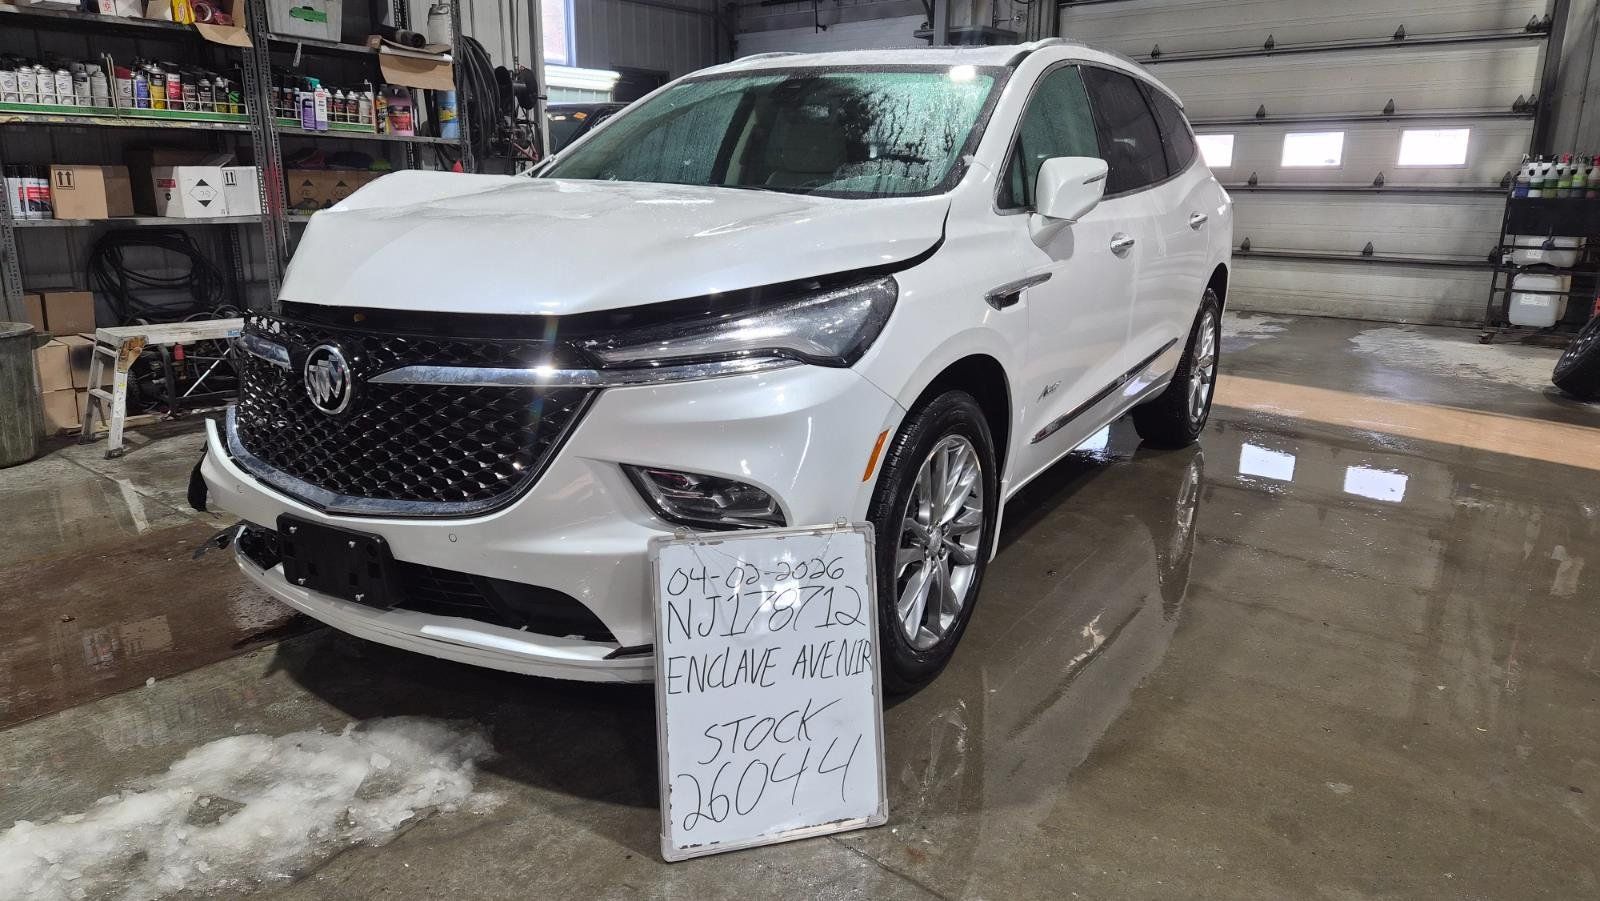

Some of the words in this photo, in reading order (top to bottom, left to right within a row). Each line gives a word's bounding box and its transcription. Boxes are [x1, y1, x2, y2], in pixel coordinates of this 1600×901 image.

[667, 557, 844, 595] 04-02-2026
[668, 585, 866, 643] NJ178712
[668, 646, 781, 695] ENCLAVE
[792, 638, 872, 679] AVENIR
[698, 698, 843, 764] STOCK
[678, 733, 862, 831] 26044
